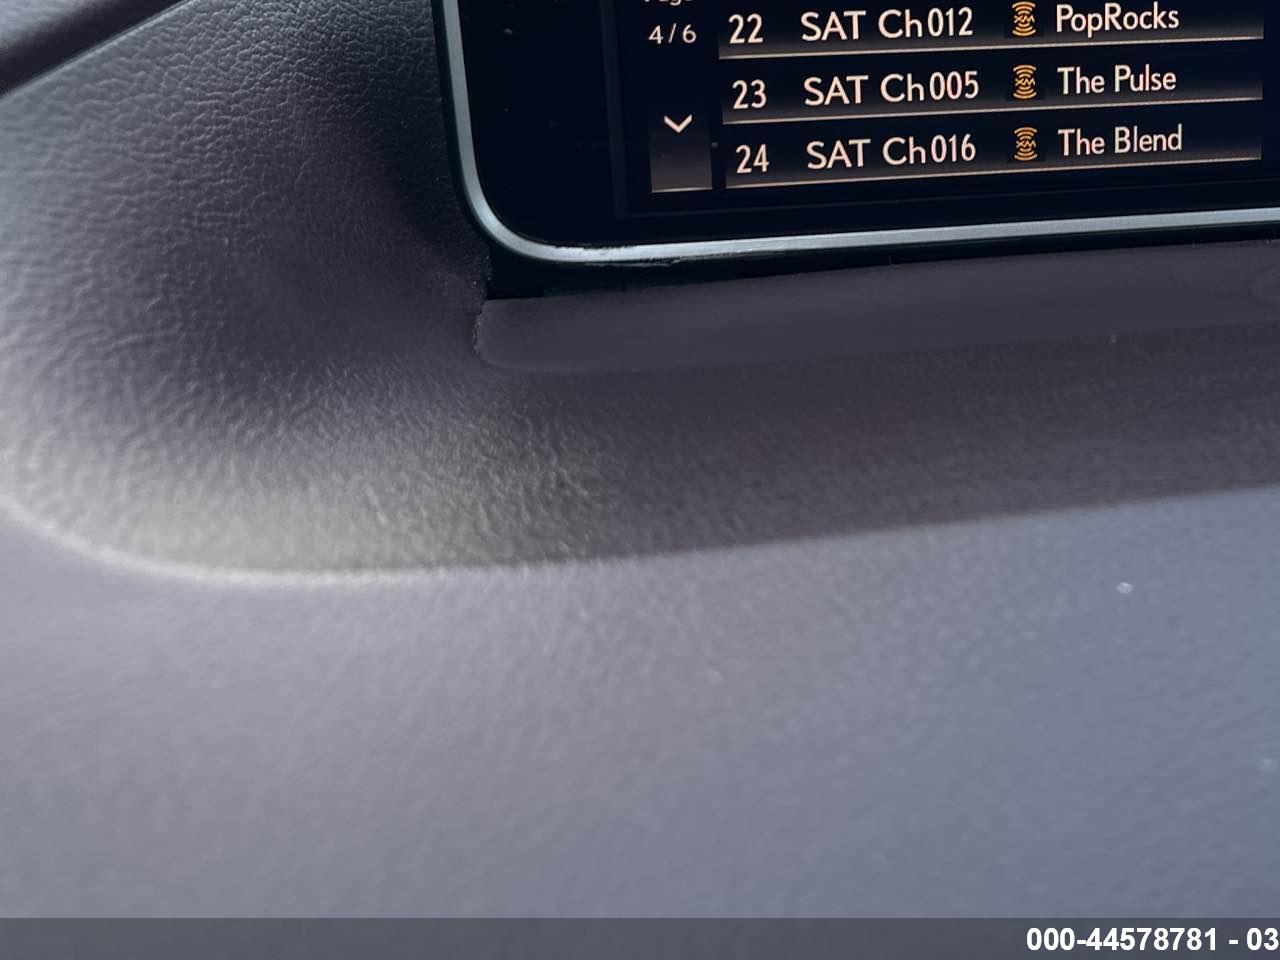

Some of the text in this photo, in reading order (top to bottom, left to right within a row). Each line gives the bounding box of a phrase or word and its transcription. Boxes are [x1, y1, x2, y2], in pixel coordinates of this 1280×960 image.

[729, 14, 762, 43] 22
[802, 11, 866, 40] SAT
[1056, 3, 1180, 37] PopRocks
[733, 80, 766, 108] 23
[805, 76, 868, 105] SAT
[1058, 64, 1176, 94] The Pulse
[1058, 124, 1181, 155] The Blend
[737, 145, 768, 173] 24
[807, 139, 870, 169] SAT
